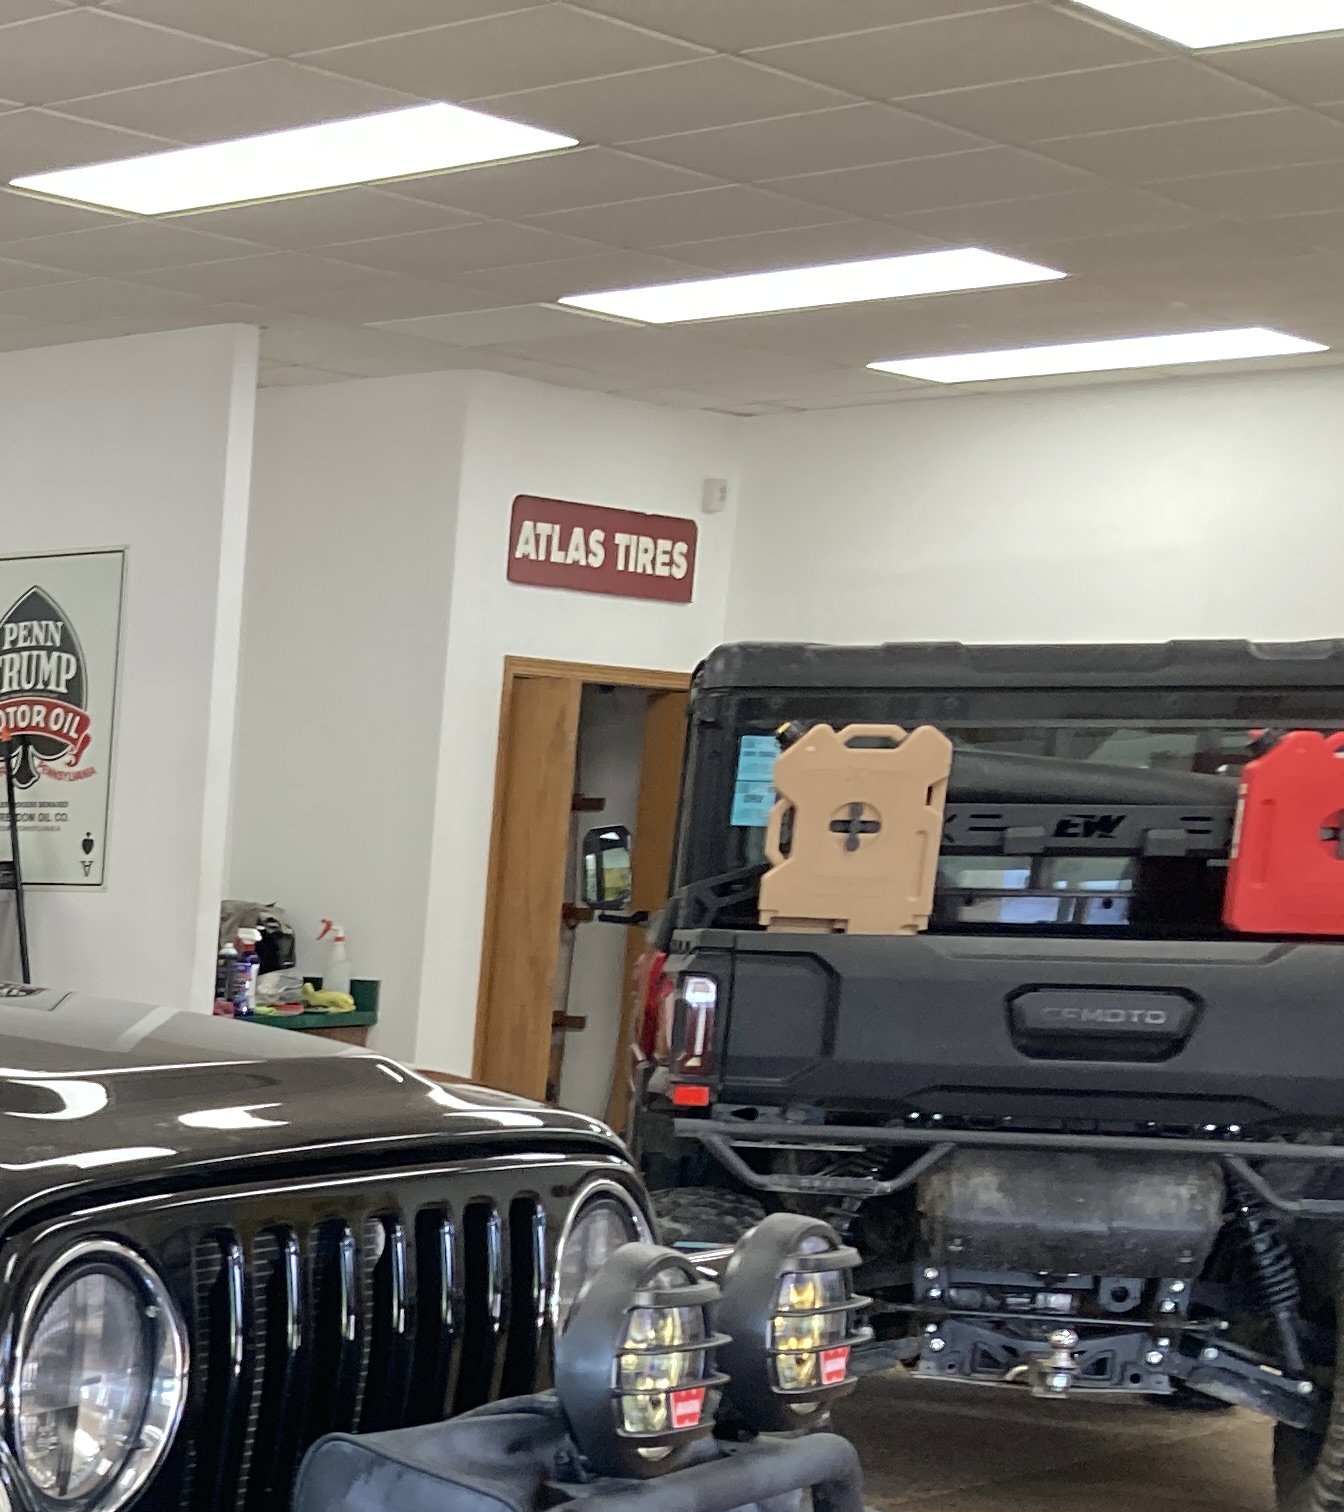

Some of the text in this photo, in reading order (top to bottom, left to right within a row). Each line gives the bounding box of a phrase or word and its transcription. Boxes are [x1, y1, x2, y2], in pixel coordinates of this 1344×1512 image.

[515, 520, 689, 580] ATLAS TIRES
[1, 620, 64, 650] PENN
[49, 707, 81, 739] OIL
